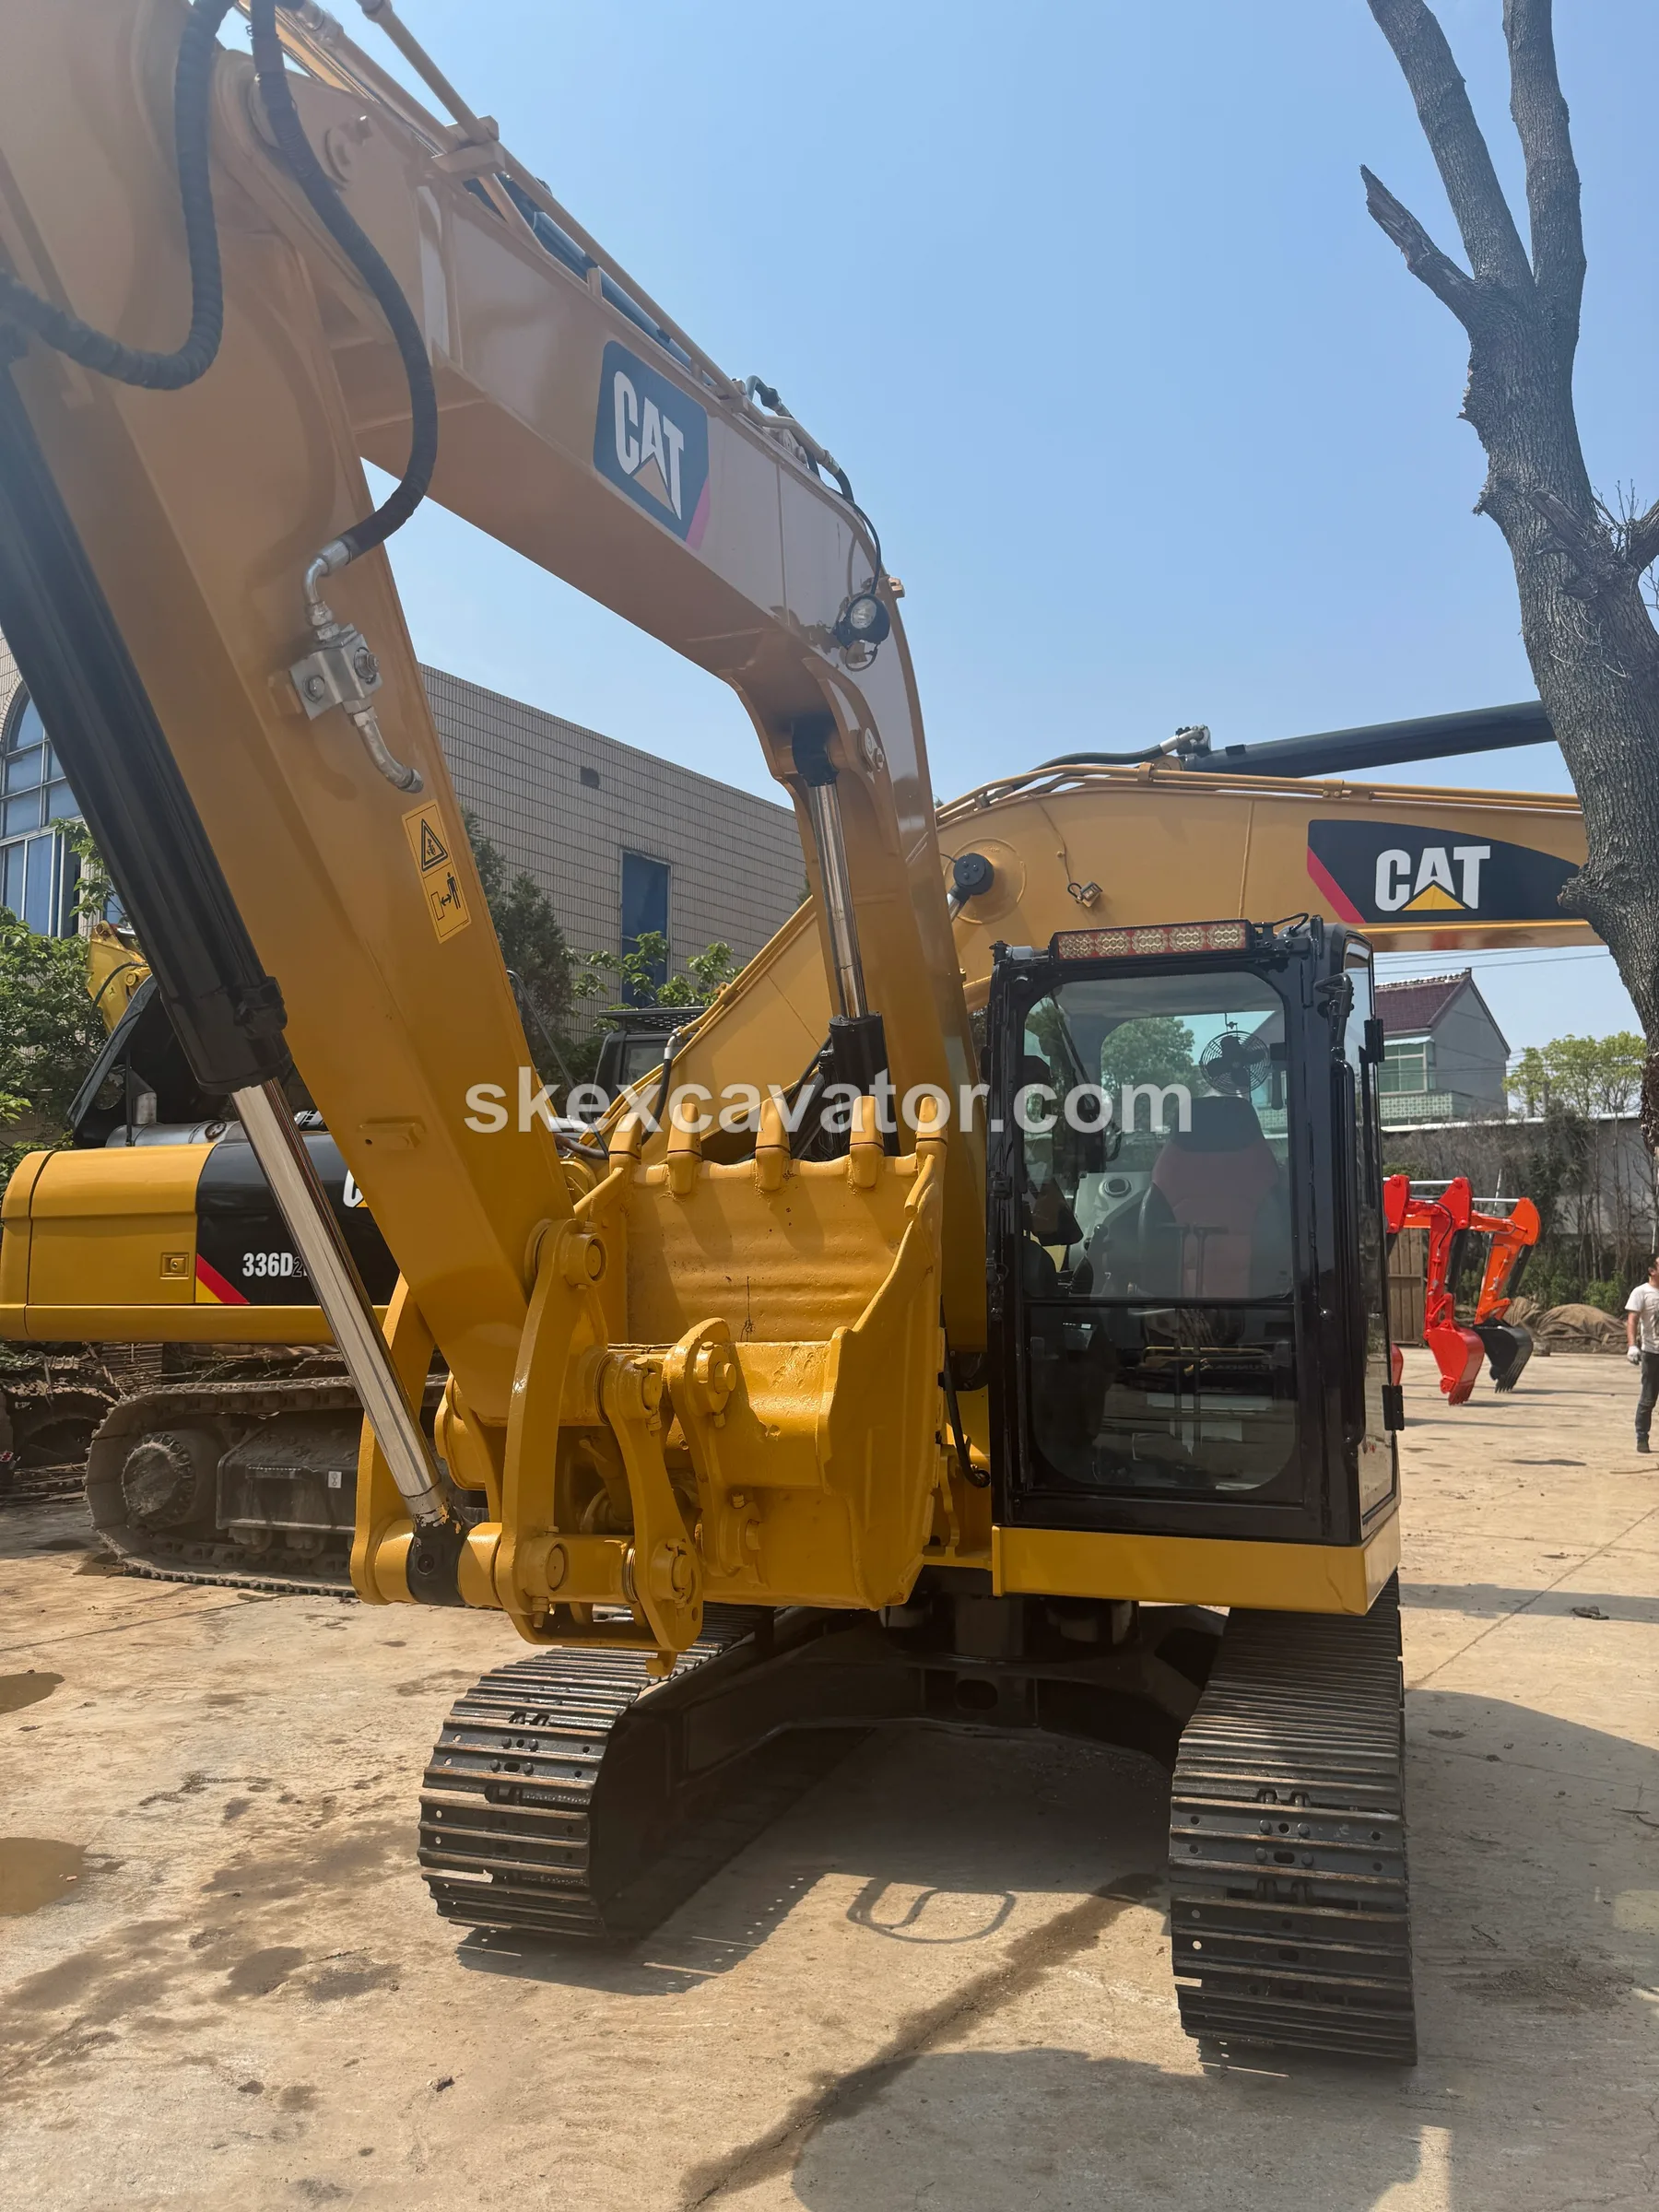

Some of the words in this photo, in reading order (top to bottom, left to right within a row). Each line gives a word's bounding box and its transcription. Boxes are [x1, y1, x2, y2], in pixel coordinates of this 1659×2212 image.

[613, 371, 684, 520] CAT
[1374, 845, 1490, 912] CAT
[242, 1252, 308, 1277] 336D2
